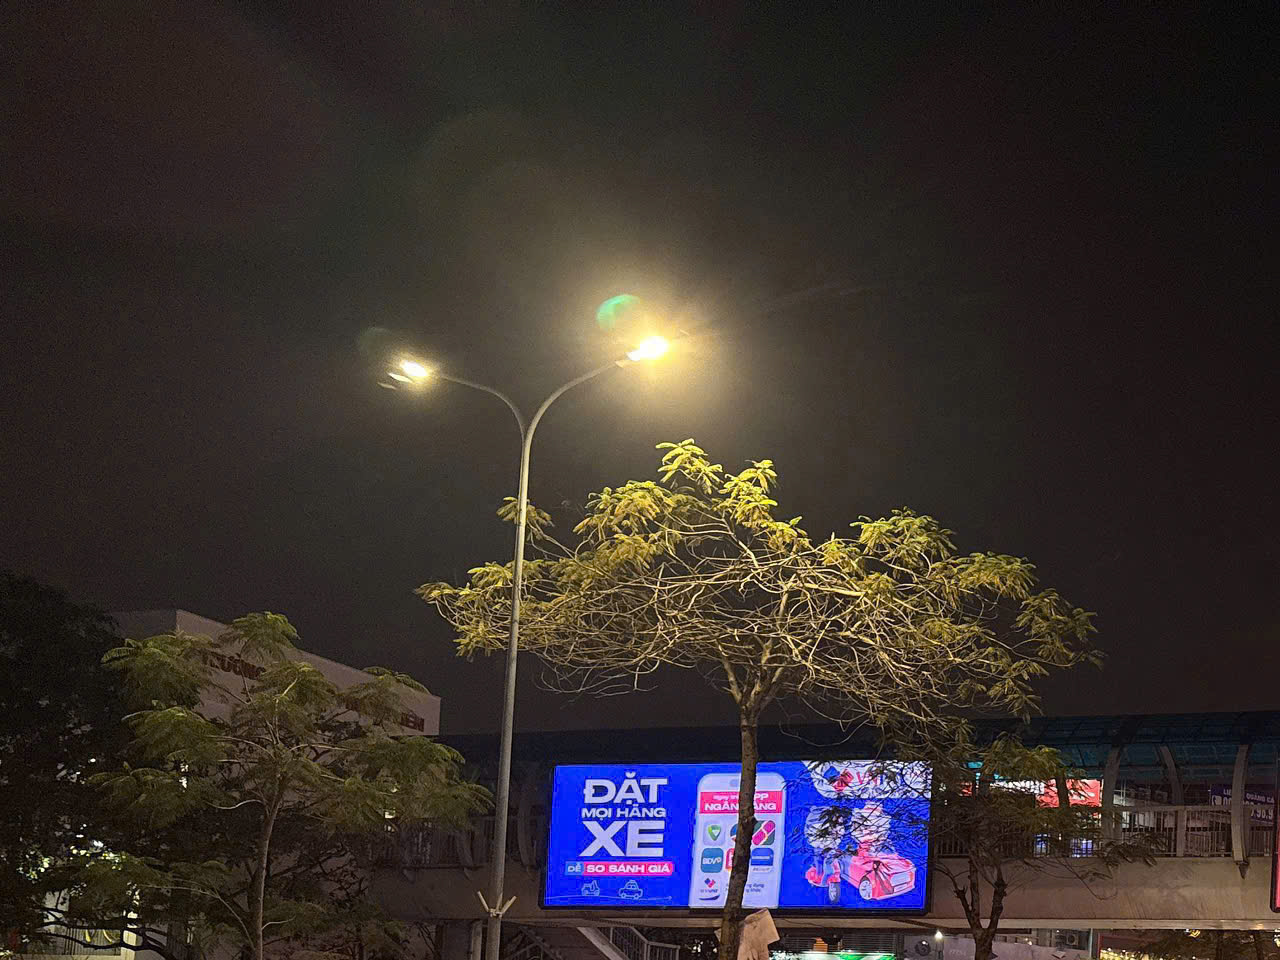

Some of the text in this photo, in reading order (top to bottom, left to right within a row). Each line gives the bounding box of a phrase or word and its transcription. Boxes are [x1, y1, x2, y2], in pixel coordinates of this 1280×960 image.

[583, 771, 668, 806] ĐẶT
[582, 807, 613, 820] MỌI
[578, 820, 665, 857] XE
[586, 862, 671, 873] SO SÁNH GIÁ
